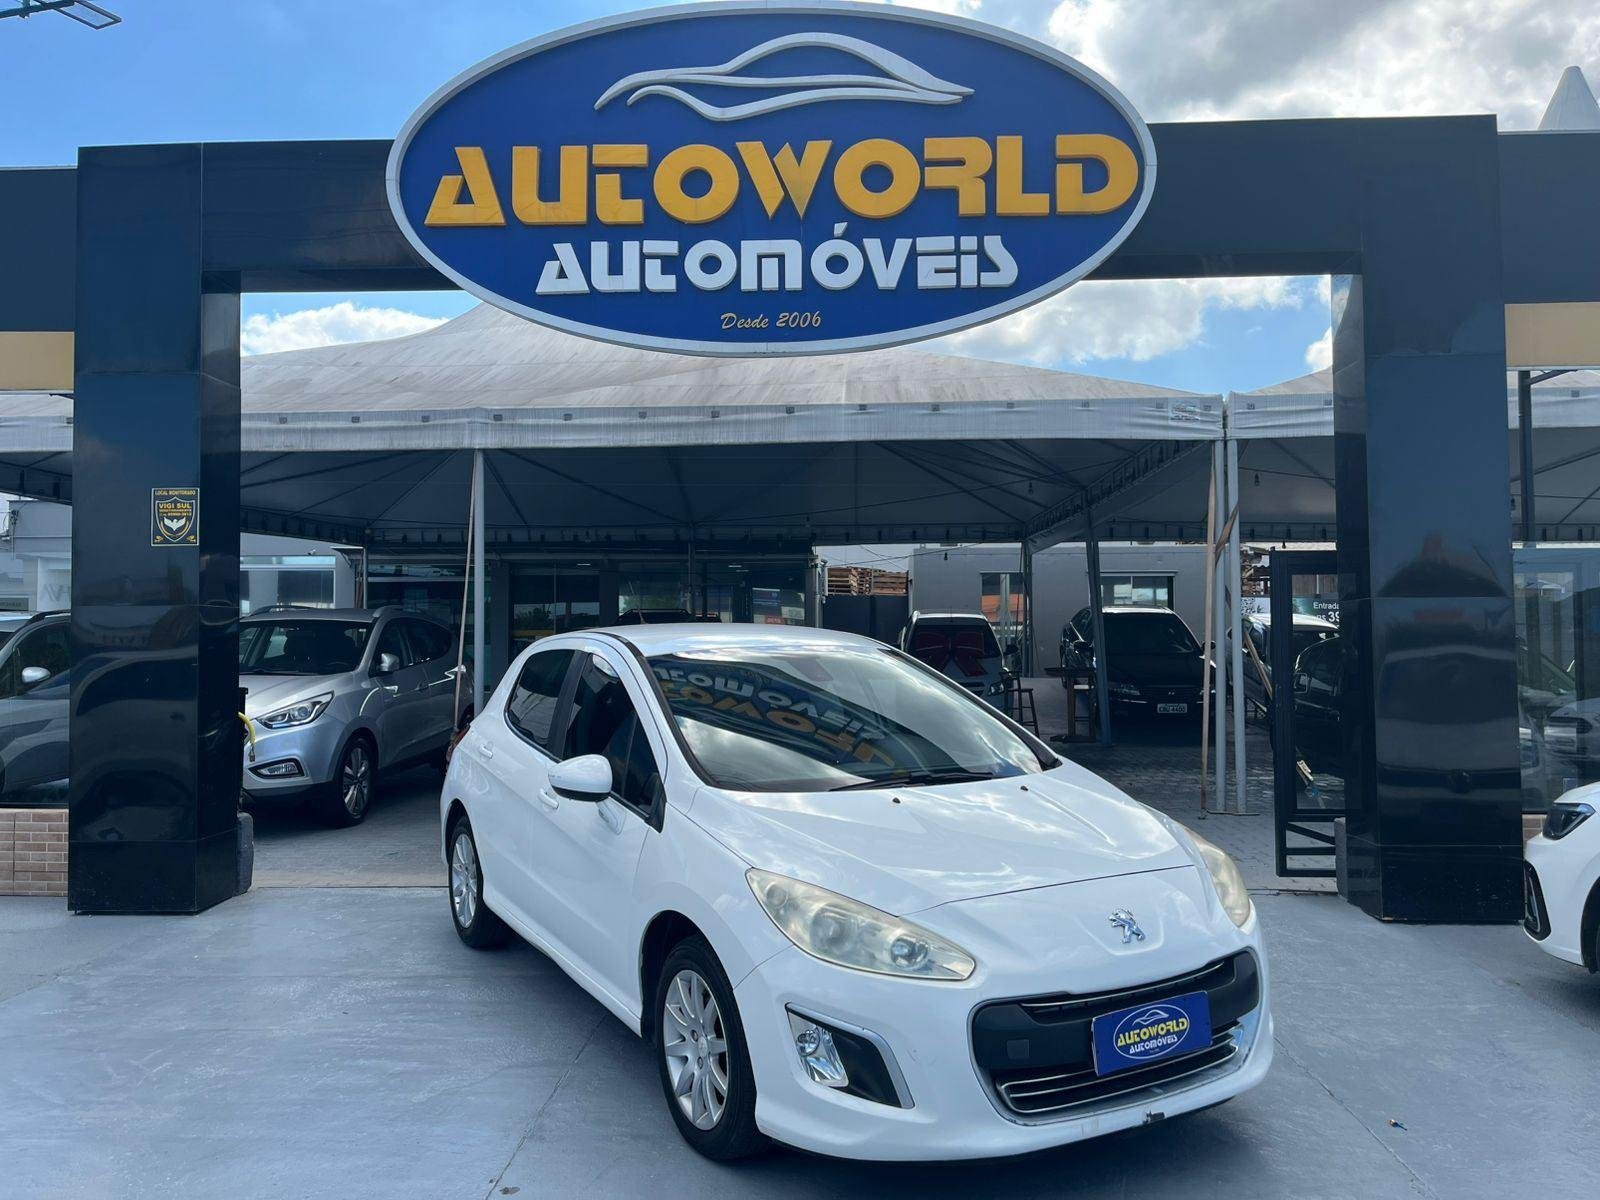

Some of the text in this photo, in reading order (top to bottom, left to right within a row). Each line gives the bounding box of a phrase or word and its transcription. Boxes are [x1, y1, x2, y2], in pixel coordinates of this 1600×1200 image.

[424, 133, 1139, 227] AUTOWORLD
[535, 221, 1019, 294] AUTOMÓVEIS
[720, 310, 822, 330] Desde 2006
[1117, 1018, 1188, 1046] AUTOWORLD
